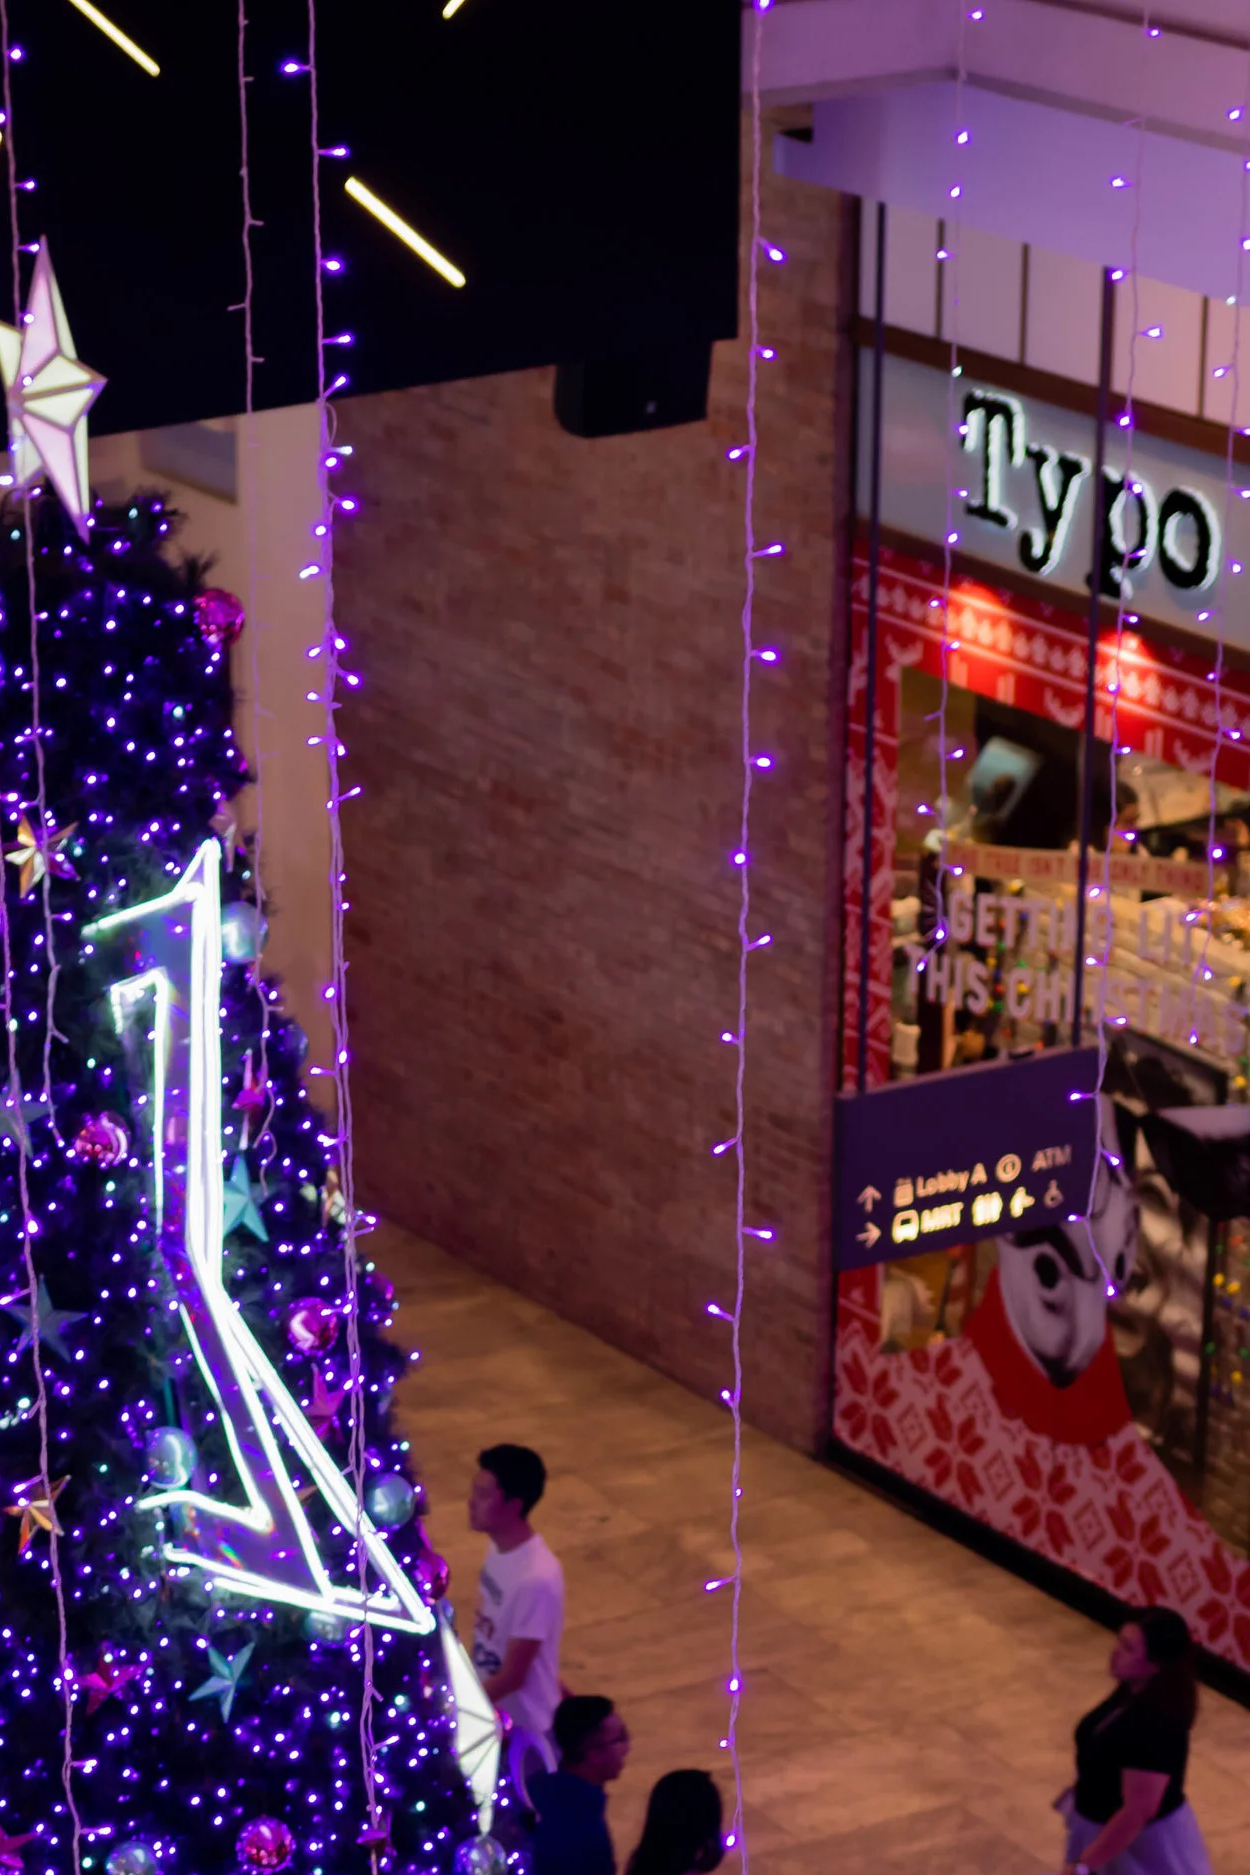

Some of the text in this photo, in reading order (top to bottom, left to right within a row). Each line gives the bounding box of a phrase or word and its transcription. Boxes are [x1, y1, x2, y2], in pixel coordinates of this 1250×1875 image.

[961, 386, 1222, 601] Typo
[902, 942, 990, 1016] THIS
[916, 1144, 1073, 1198] Lobby A ATM
